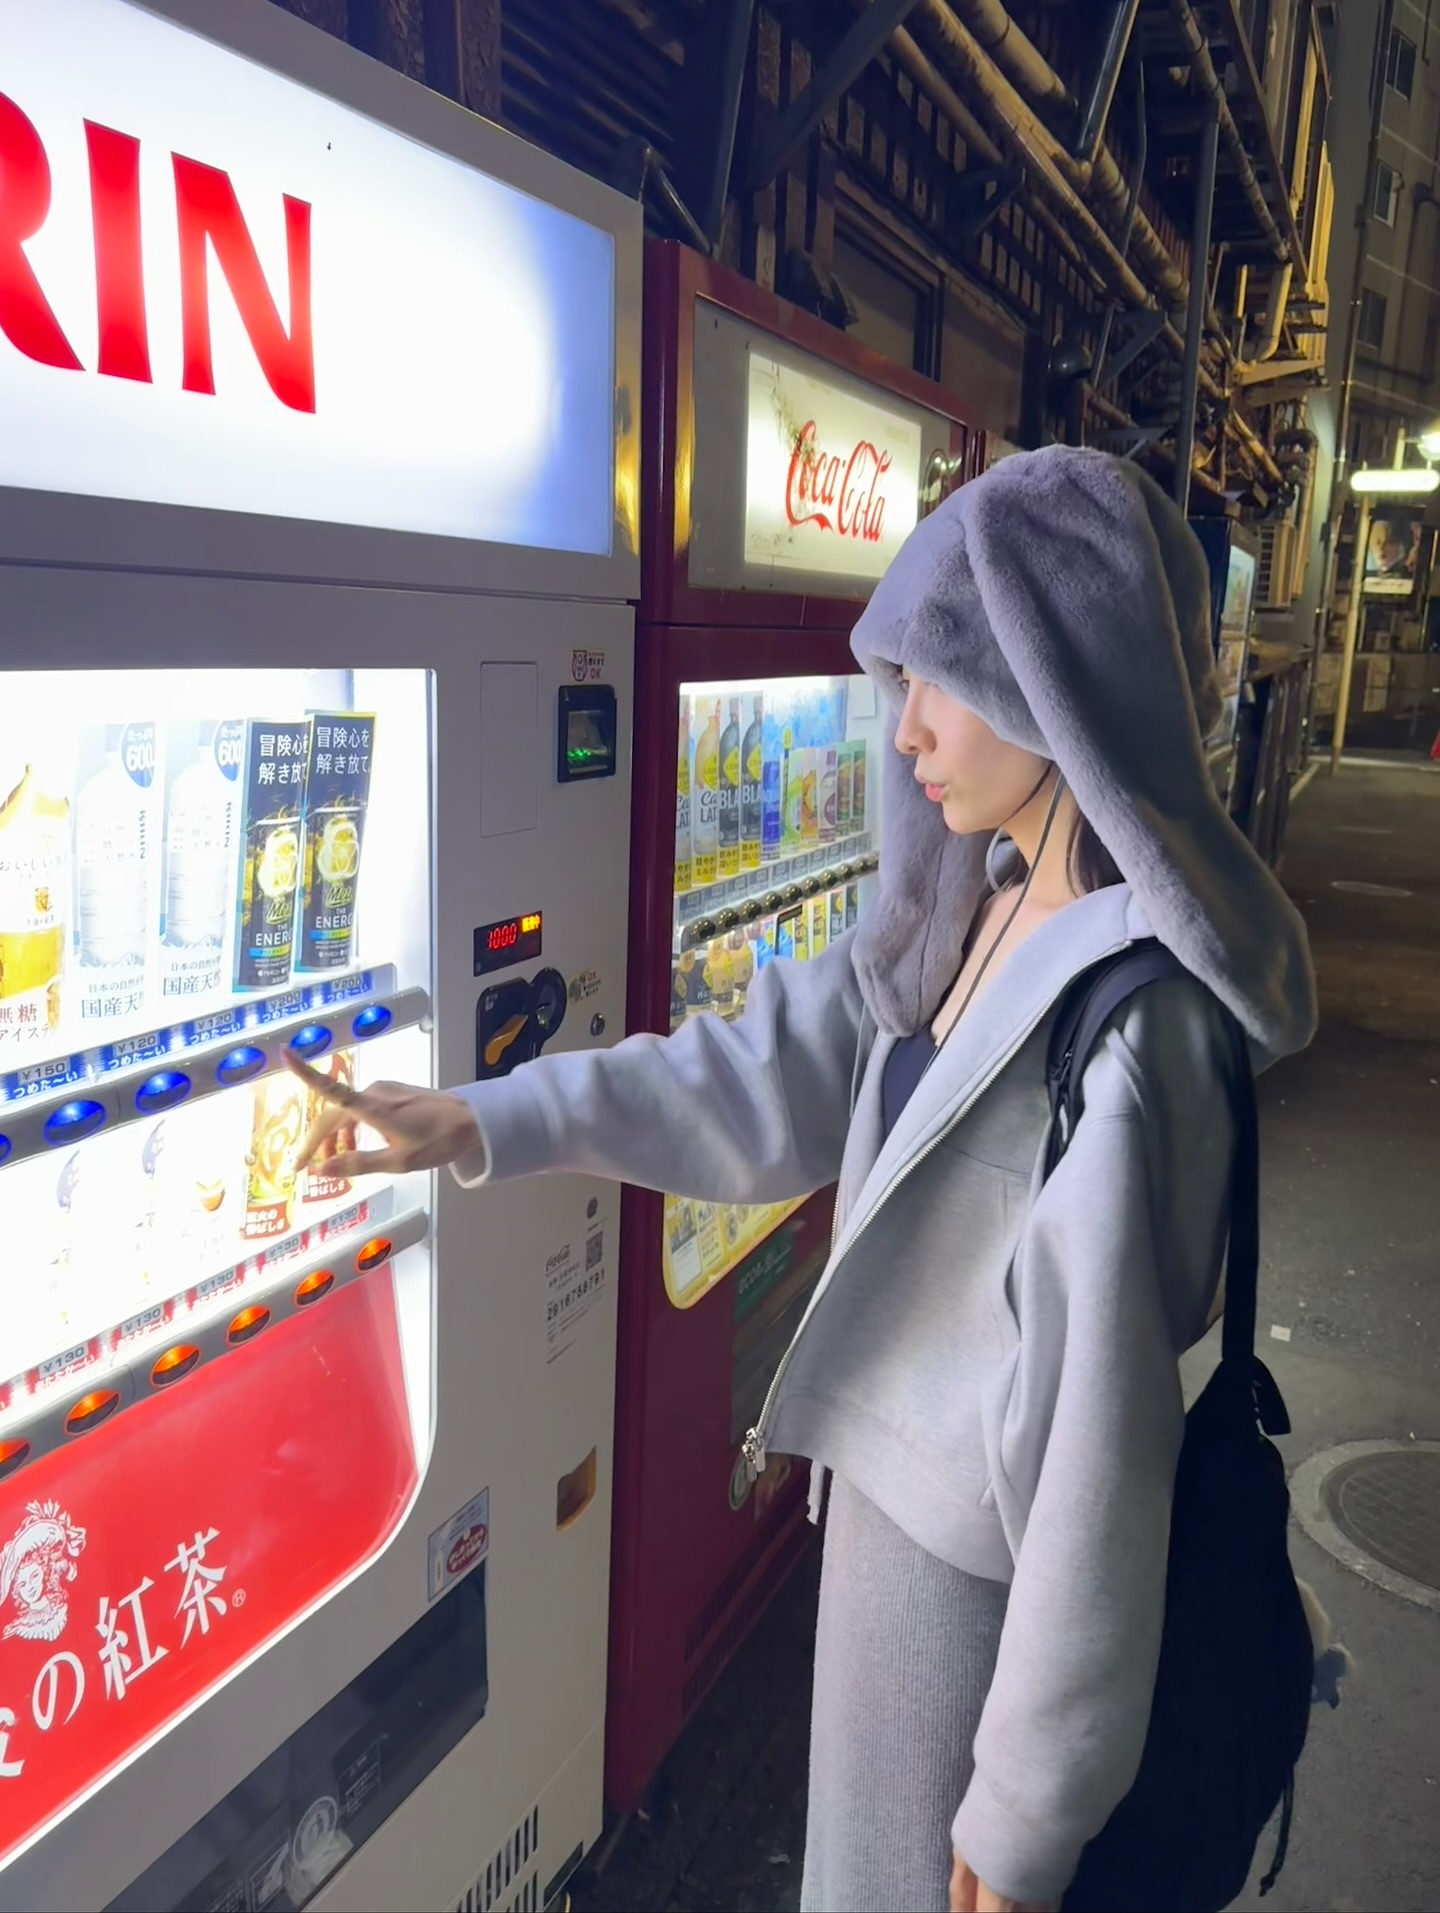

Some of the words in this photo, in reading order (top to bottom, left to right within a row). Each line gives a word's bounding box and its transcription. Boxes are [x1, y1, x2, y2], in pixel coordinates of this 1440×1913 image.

[316, 726, 370, 749] 冒険心を
[488, 922, 518, 950] 1000
[198, 1012, 232, 1030] ¥120
[118, 1034, 156, 1053] ¥120
[22, 1062, 66, 1080] ¥150
[200, 1270, 234, 1292] ¥130
[123, 1306, 162, 1332] ¥130
[42, 1346, 86, 1374] ¥130
